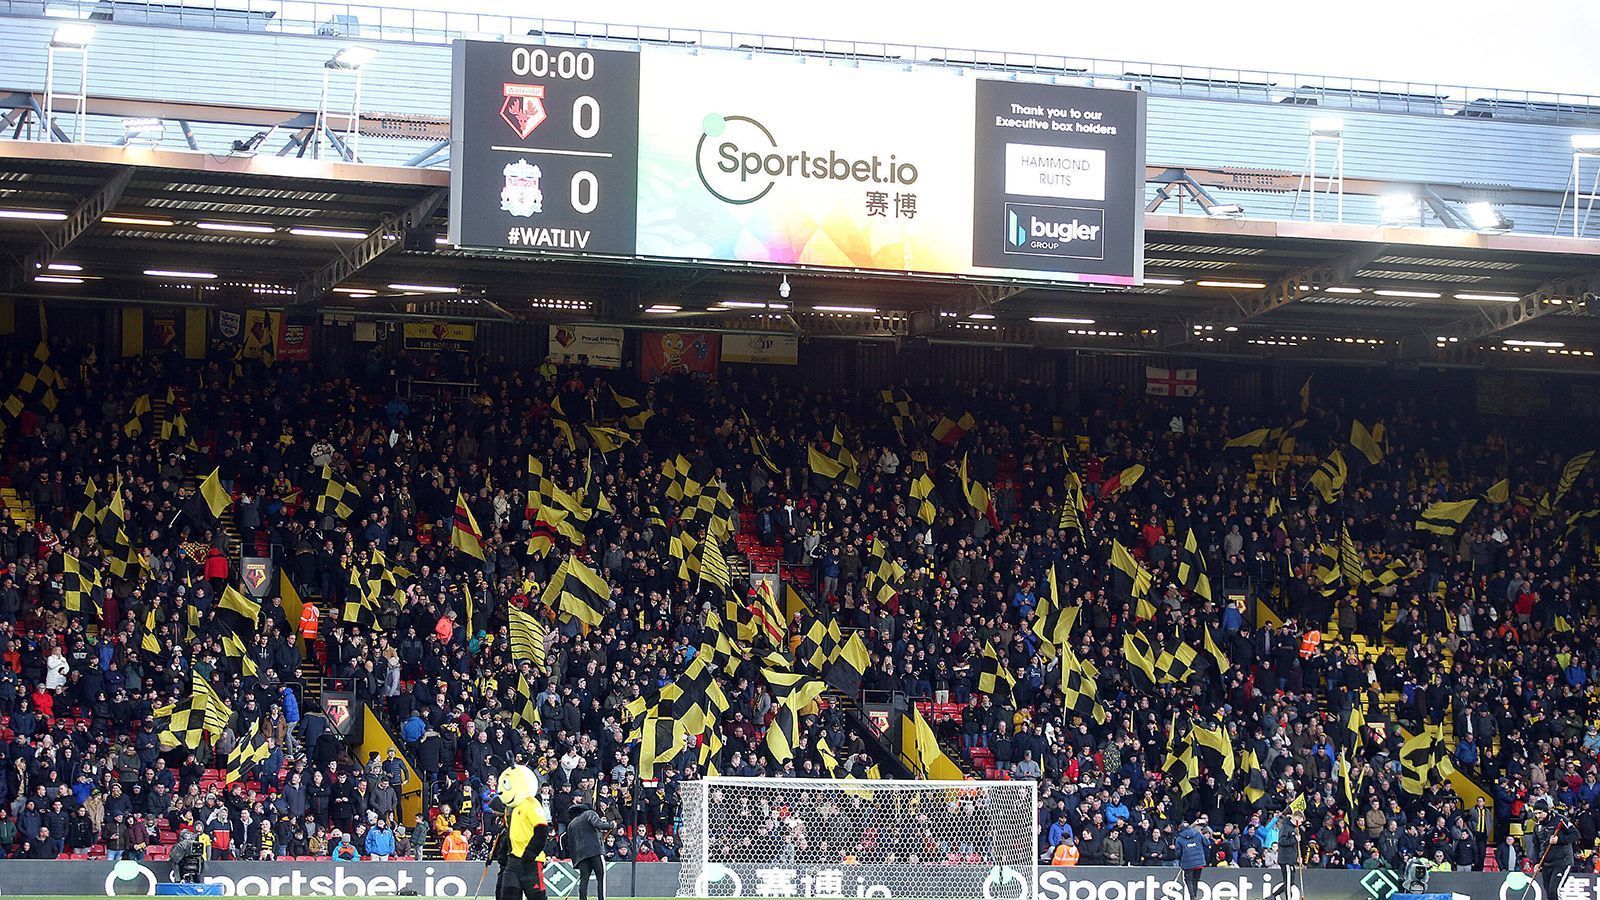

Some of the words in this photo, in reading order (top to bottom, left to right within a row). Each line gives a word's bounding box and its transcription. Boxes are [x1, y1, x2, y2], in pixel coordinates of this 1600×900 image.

[511, 47, 595, 81] 00:00
[572, 95, 600, 139] 0
[1011, 103, 1044, 116] Thank
[1047, 107, 1067, 119] you
[1070, 107, 1081, 119] to
[1083, 110, 1102, 120] our
[995, 116, 1049, 130] Executive
[1051, 120, 1073, 132] box
[1075, 122, 1117, 135] holders
[717, 142, 918, 185] Sportsbet.io
[1021, 156, 1090, 171] HAMMOND
[570, 170, 599, 214] 0
[1039, 173, 1071, 186] RUTTS
[865, 190, 918, 219] 赛博
[507, 227, 591, 249] #WATLIV
[1030, 215, 1100, 242] bugler
[1030, 241, 1059, 250] GROUP
[169, 865, 468, 896] portsbetio
